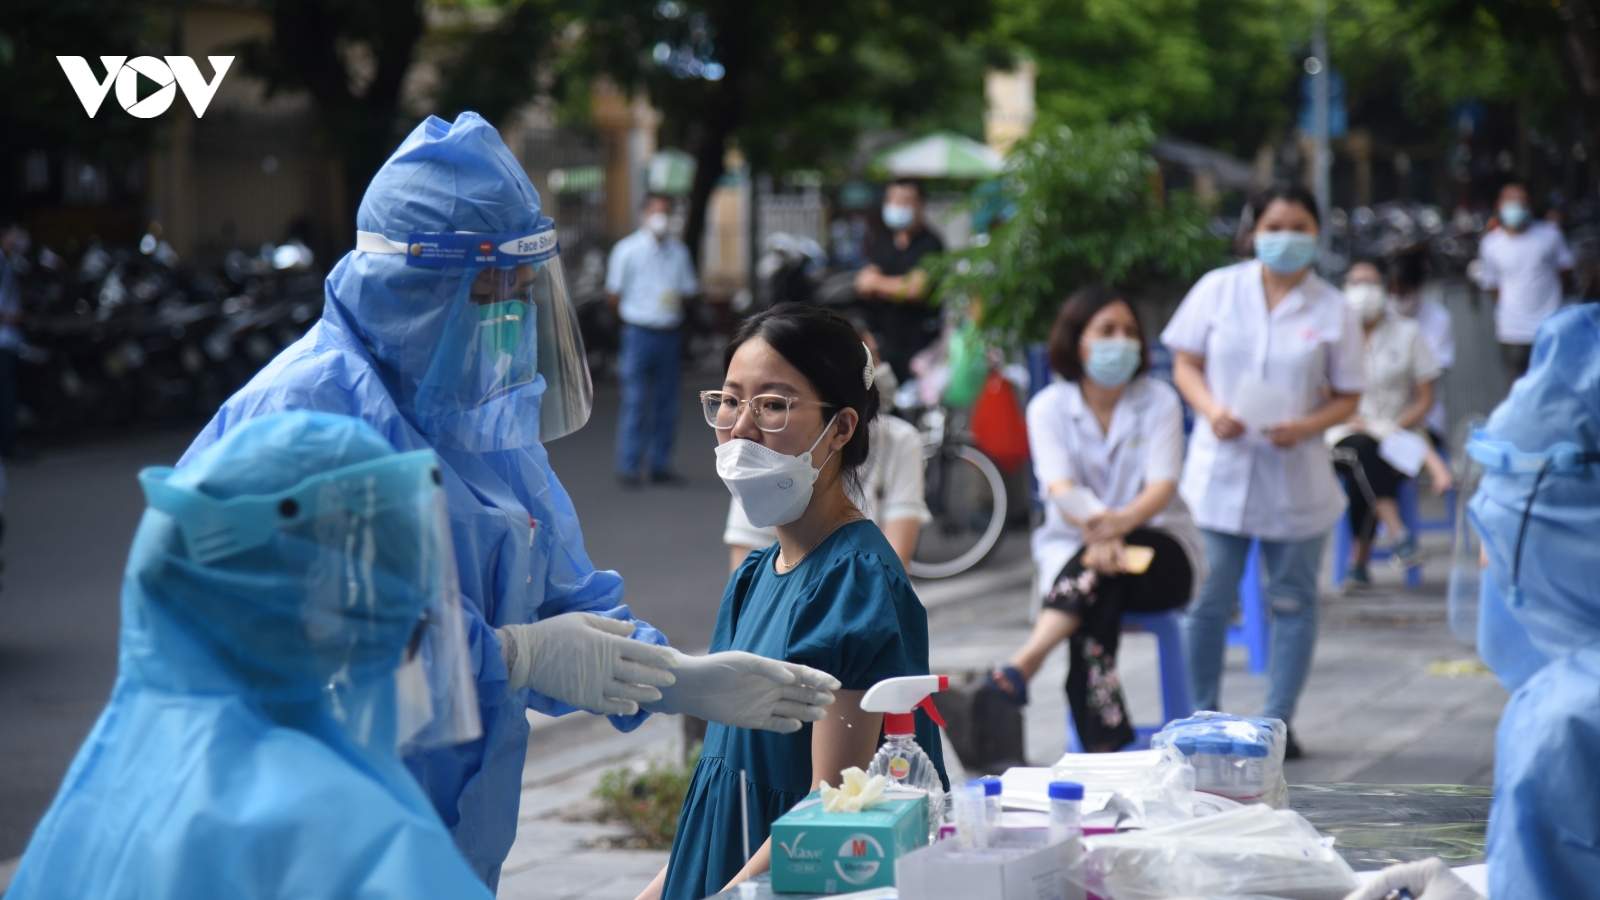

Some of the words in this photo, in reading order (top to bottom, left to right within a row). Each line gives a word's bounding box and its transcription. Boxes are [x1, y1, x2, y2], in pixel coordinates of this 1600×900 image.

[518, 240, 538, 253] Face
[852, 839, 867, 857] M
[844, 863, 875, 872] Medium
